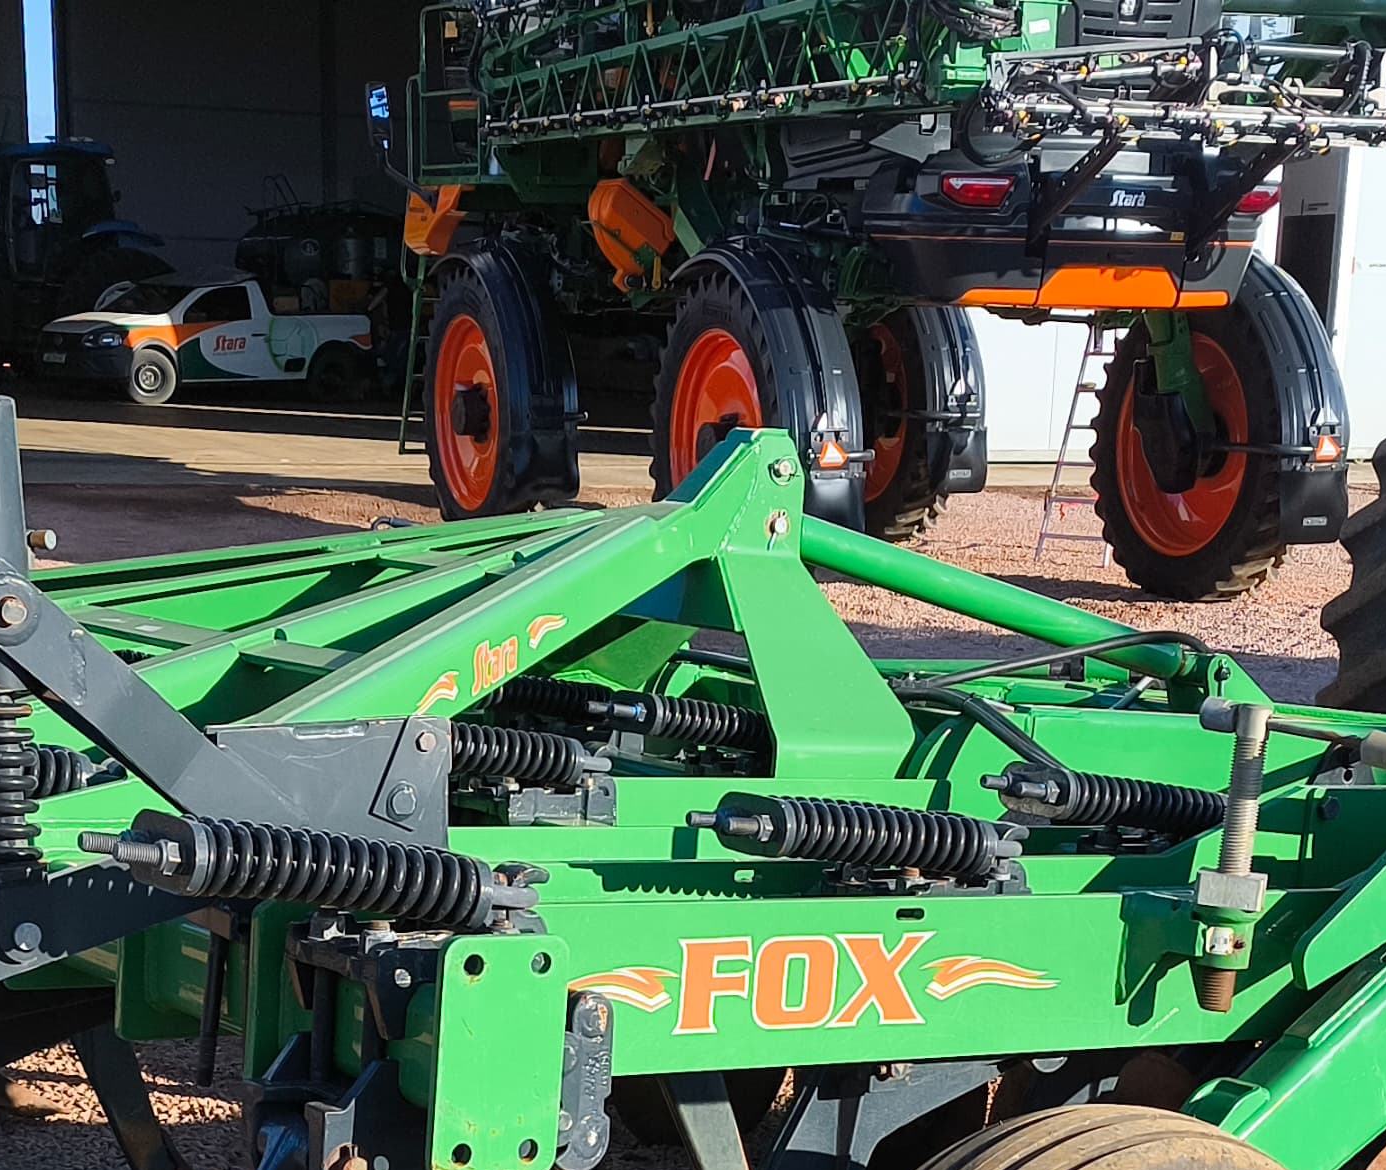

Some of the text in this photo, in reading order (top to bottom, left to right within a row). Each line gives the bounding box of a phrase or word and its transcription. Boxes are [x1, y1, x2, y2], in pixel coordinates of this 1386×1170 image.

[1108, 189, 1146, 207] Stara
[214, 335, 247, 352] Stara
[472, 636, 518, 697] Stara
[671, 931, 938, 1035] FOX
